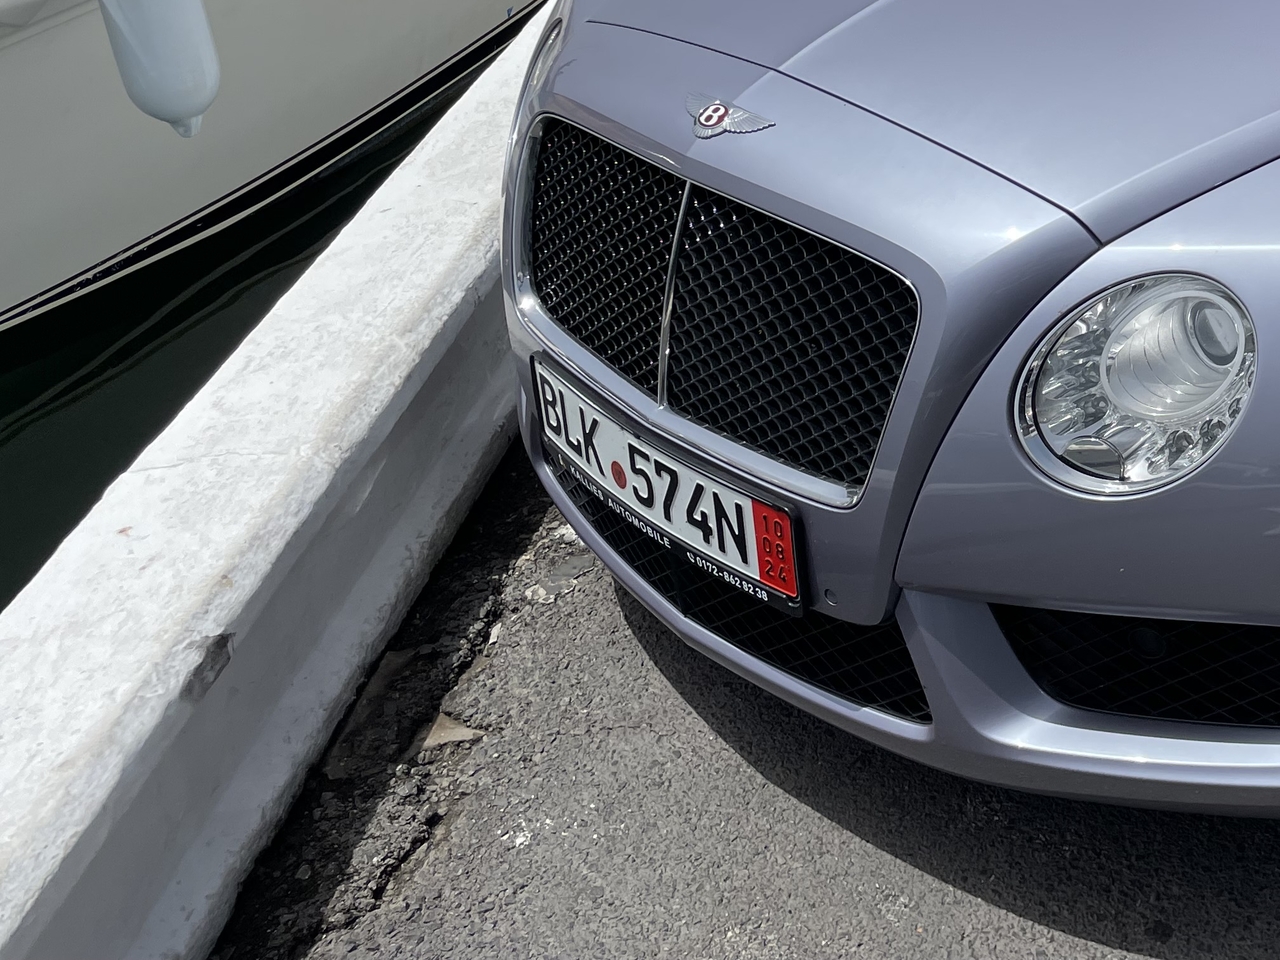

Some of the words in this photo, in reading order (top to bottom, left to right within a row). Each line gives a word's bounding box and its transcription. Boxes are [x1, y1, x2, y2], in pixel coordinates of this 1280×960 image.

[539, 370, 606, 479] BLK
[627, 442, 748, 565] 574N
[569, 465, 604, 501] KALLIES
[608, 498, 672, 549] AUTOMOBILE
[762, 513, 784, 539] 10
[762, 534, 786, 561] 08
[764, 557, 788, 583] 24
